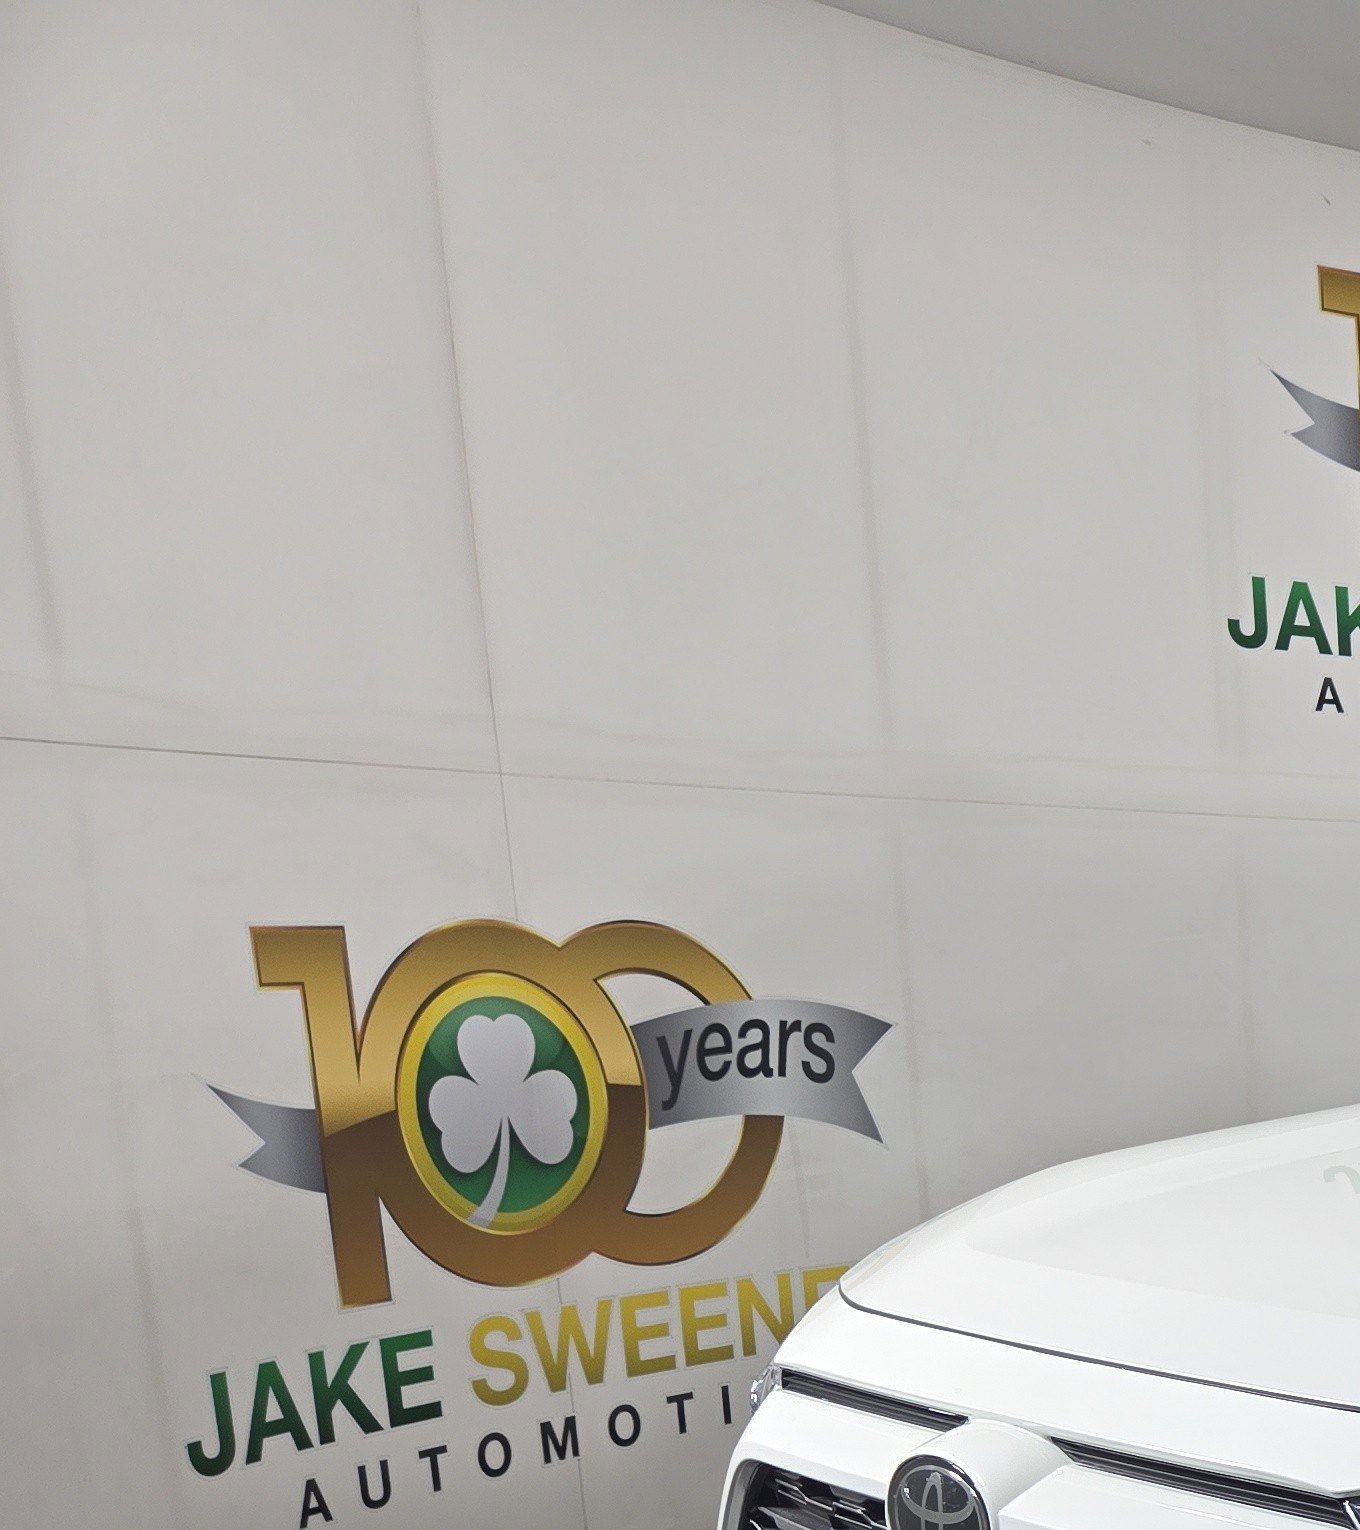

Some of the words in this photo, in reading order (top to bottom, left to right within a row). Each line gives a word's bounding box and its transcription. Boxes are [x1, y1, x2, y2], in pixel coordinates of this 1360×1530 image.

[250, 919, 784, 1309] 100
[655, 1017, 836, 1110] years
[186, 1330, 443, 1477] JAKE
[300, 1385, 732, 1530] AUTOMOTI
